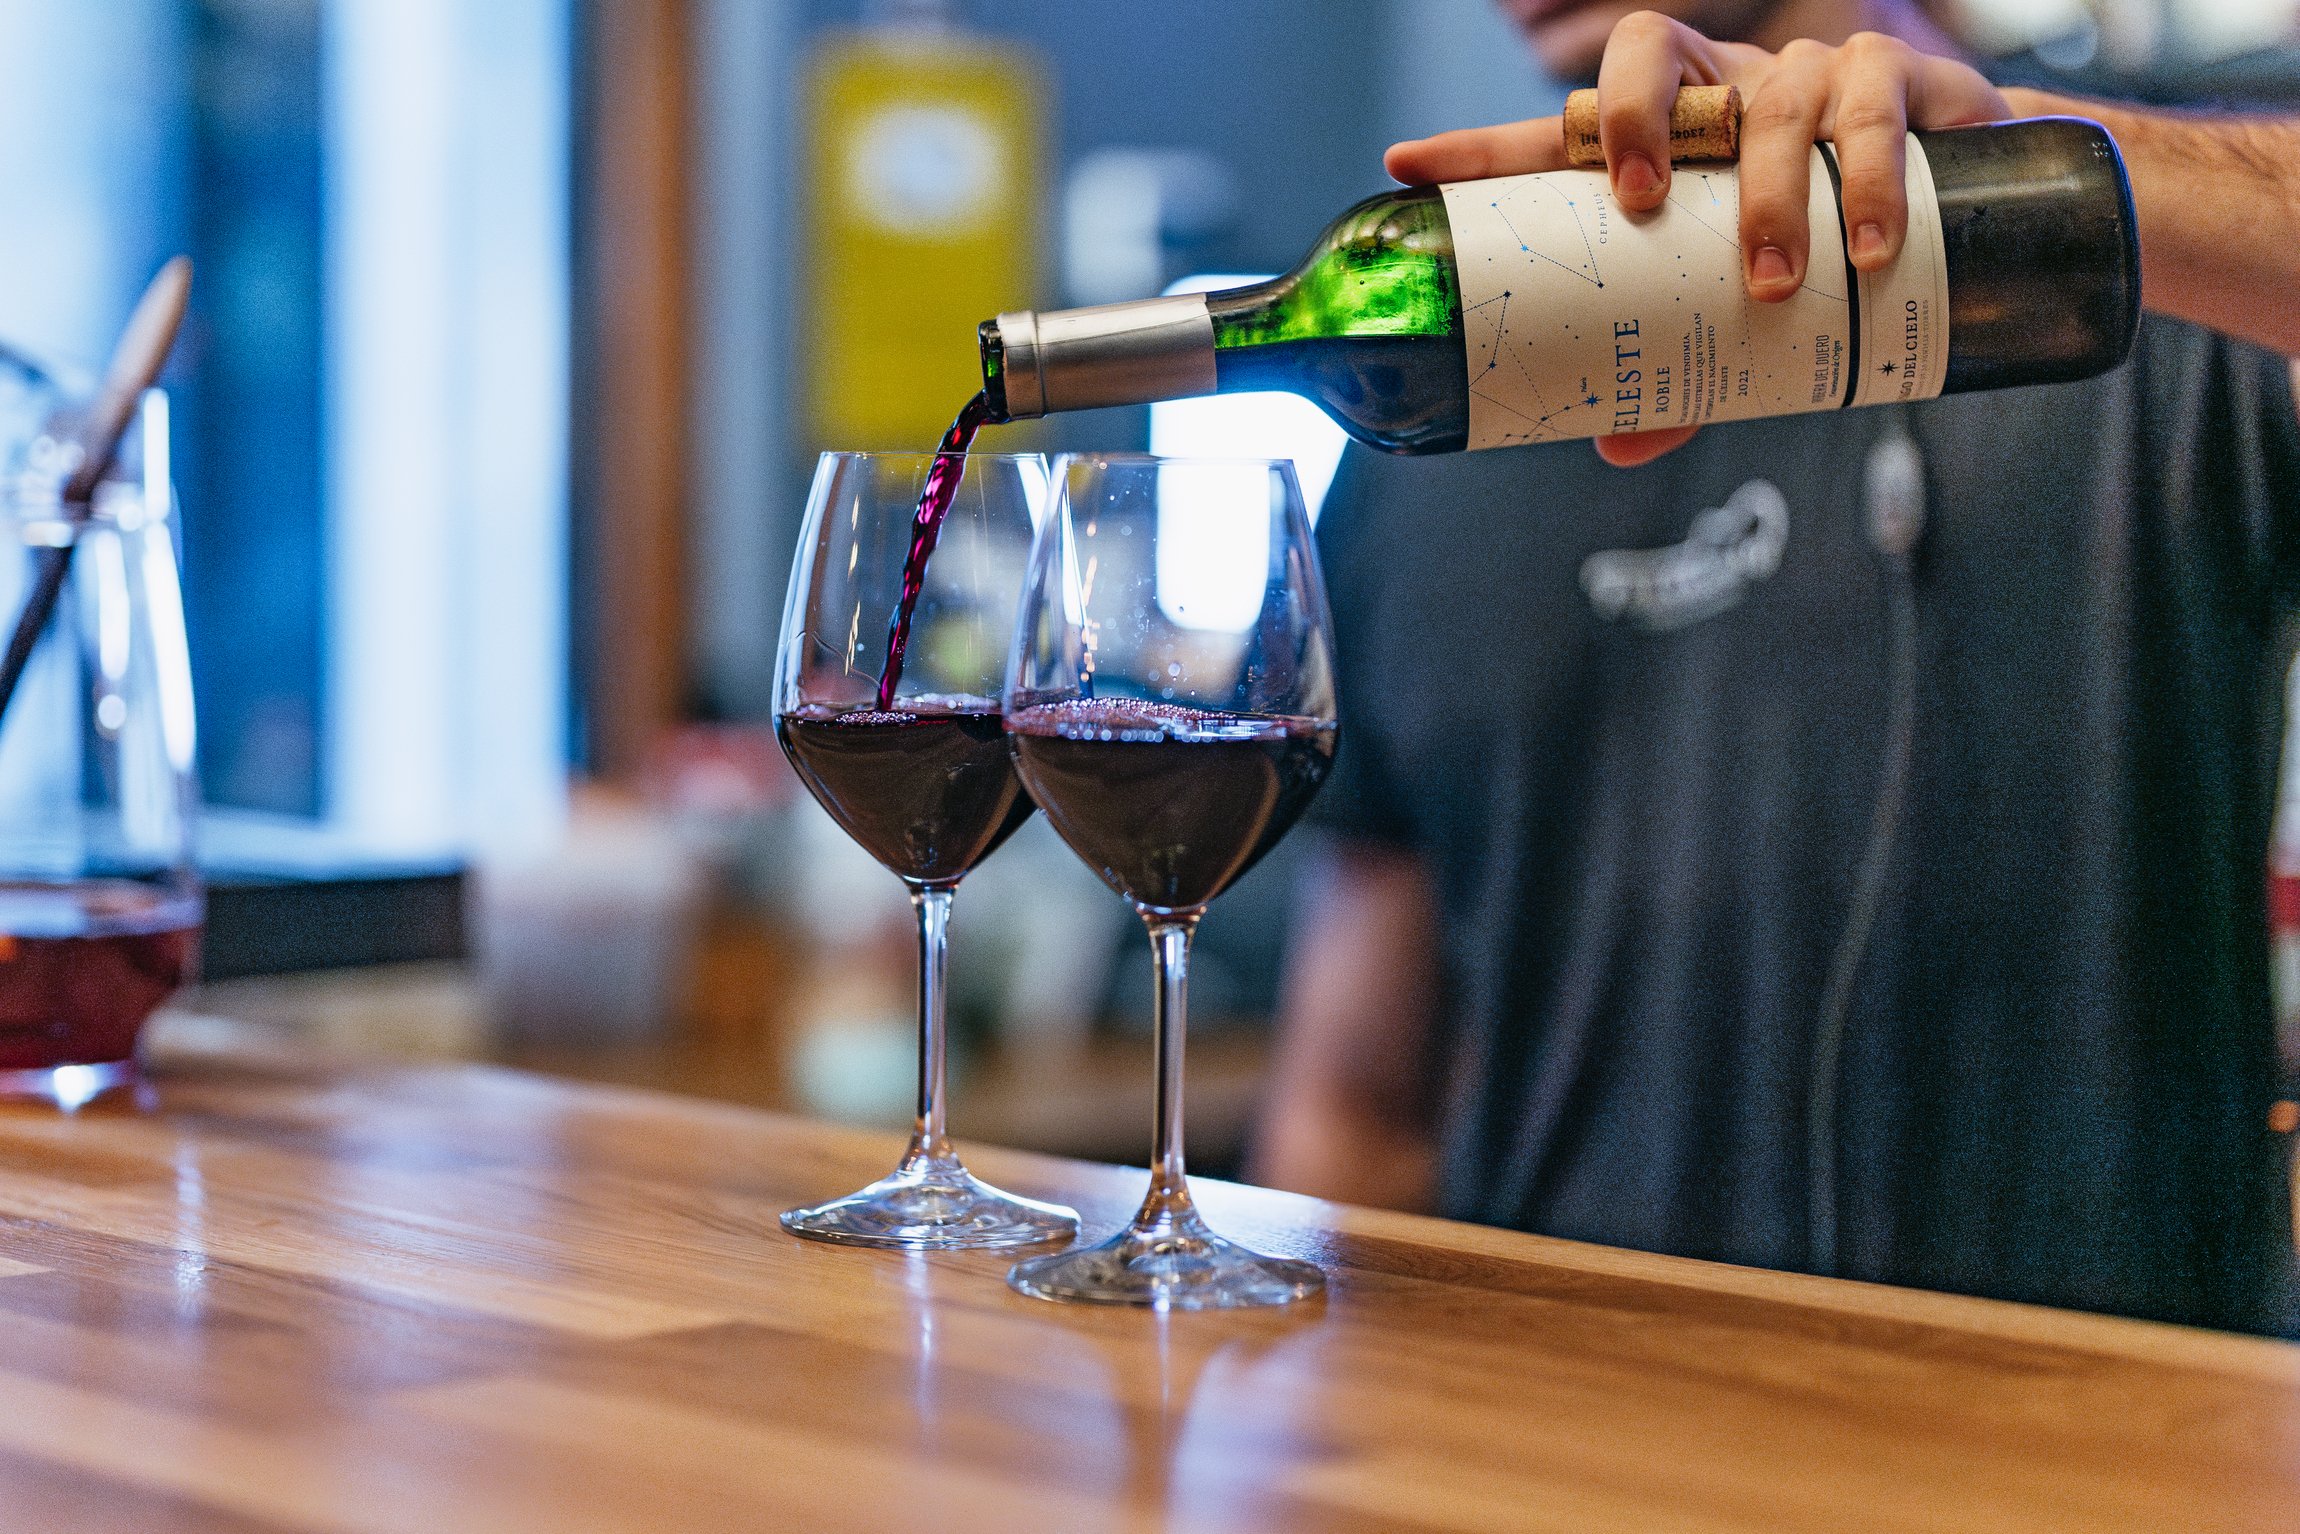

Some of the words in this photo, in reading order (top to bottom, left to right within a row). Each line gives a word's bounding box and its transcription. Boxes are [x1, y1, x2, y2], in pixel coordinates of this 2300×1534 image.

[1593, 193, 1607, 244] CEPHEUS
[1694, 313, 1702, 349] VIGILAN
[1905, 300, 1917, 350] CIELO
[1696, 351, 1705, 368] QUE
[1708, 325, 1716, 378] NACIMIENTO
[1816, 334, 1829, 365] DUERO
[1832, 340, 1843, 361] Origen
[1815, 366, 1829, 381] DEL
[1904, 353, 1917, 378] DEL
[1655, 366, 1670, 413] ROBLE
[1684, 378, 1691, 387] DE
[1738, 369, 1748, 397] 2022
